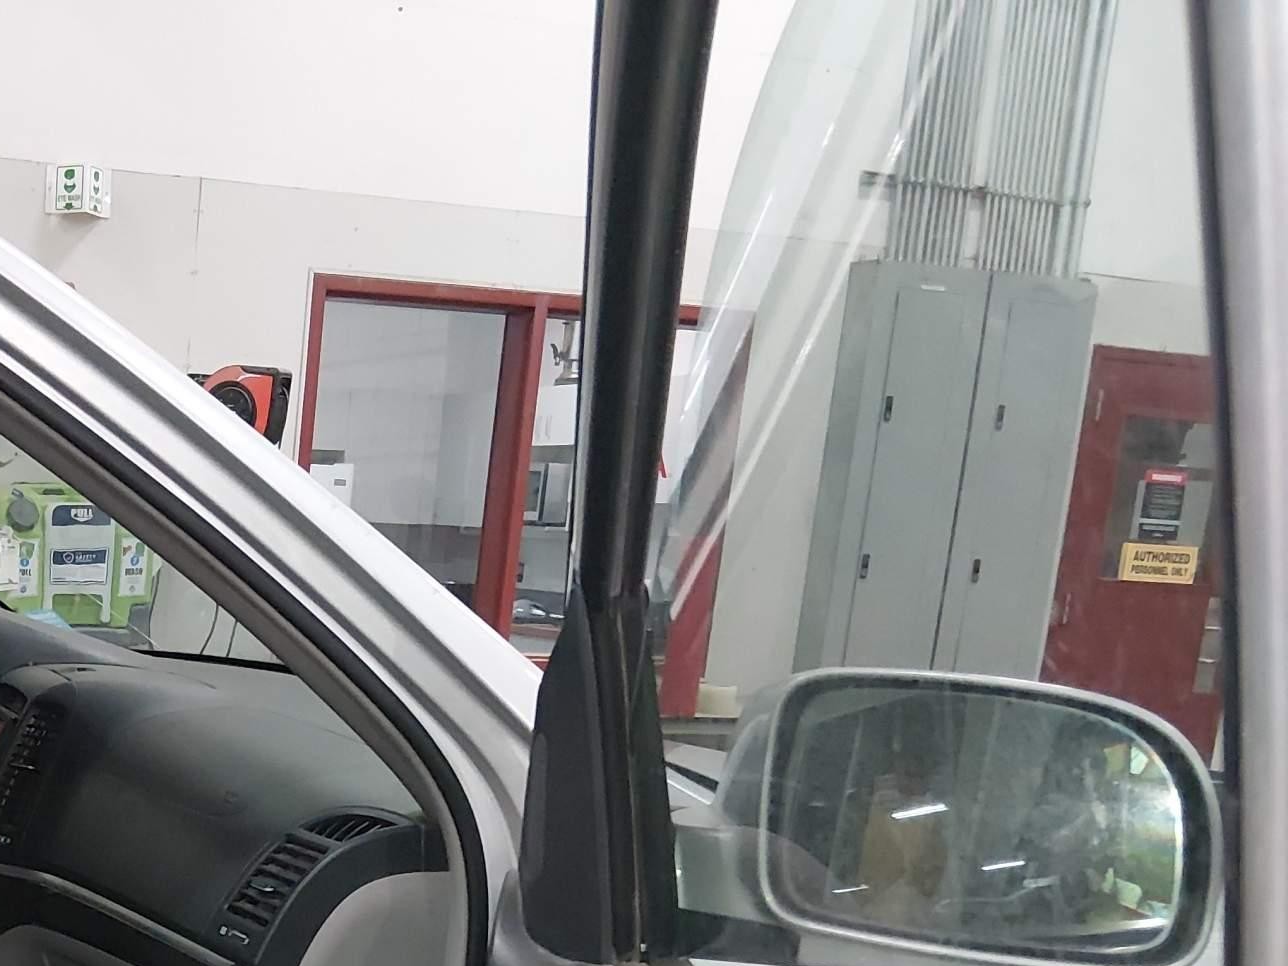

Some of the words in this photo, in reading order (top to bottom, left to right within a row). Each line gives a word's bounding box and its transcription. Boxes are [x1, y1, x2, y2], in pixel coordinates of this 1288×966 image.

[1132, 550, 1191, 565] AUTHORIZED
[1130, 564, 1169, 576] PERSONNEL
[1170, 567, 1190, 577] ONLY
